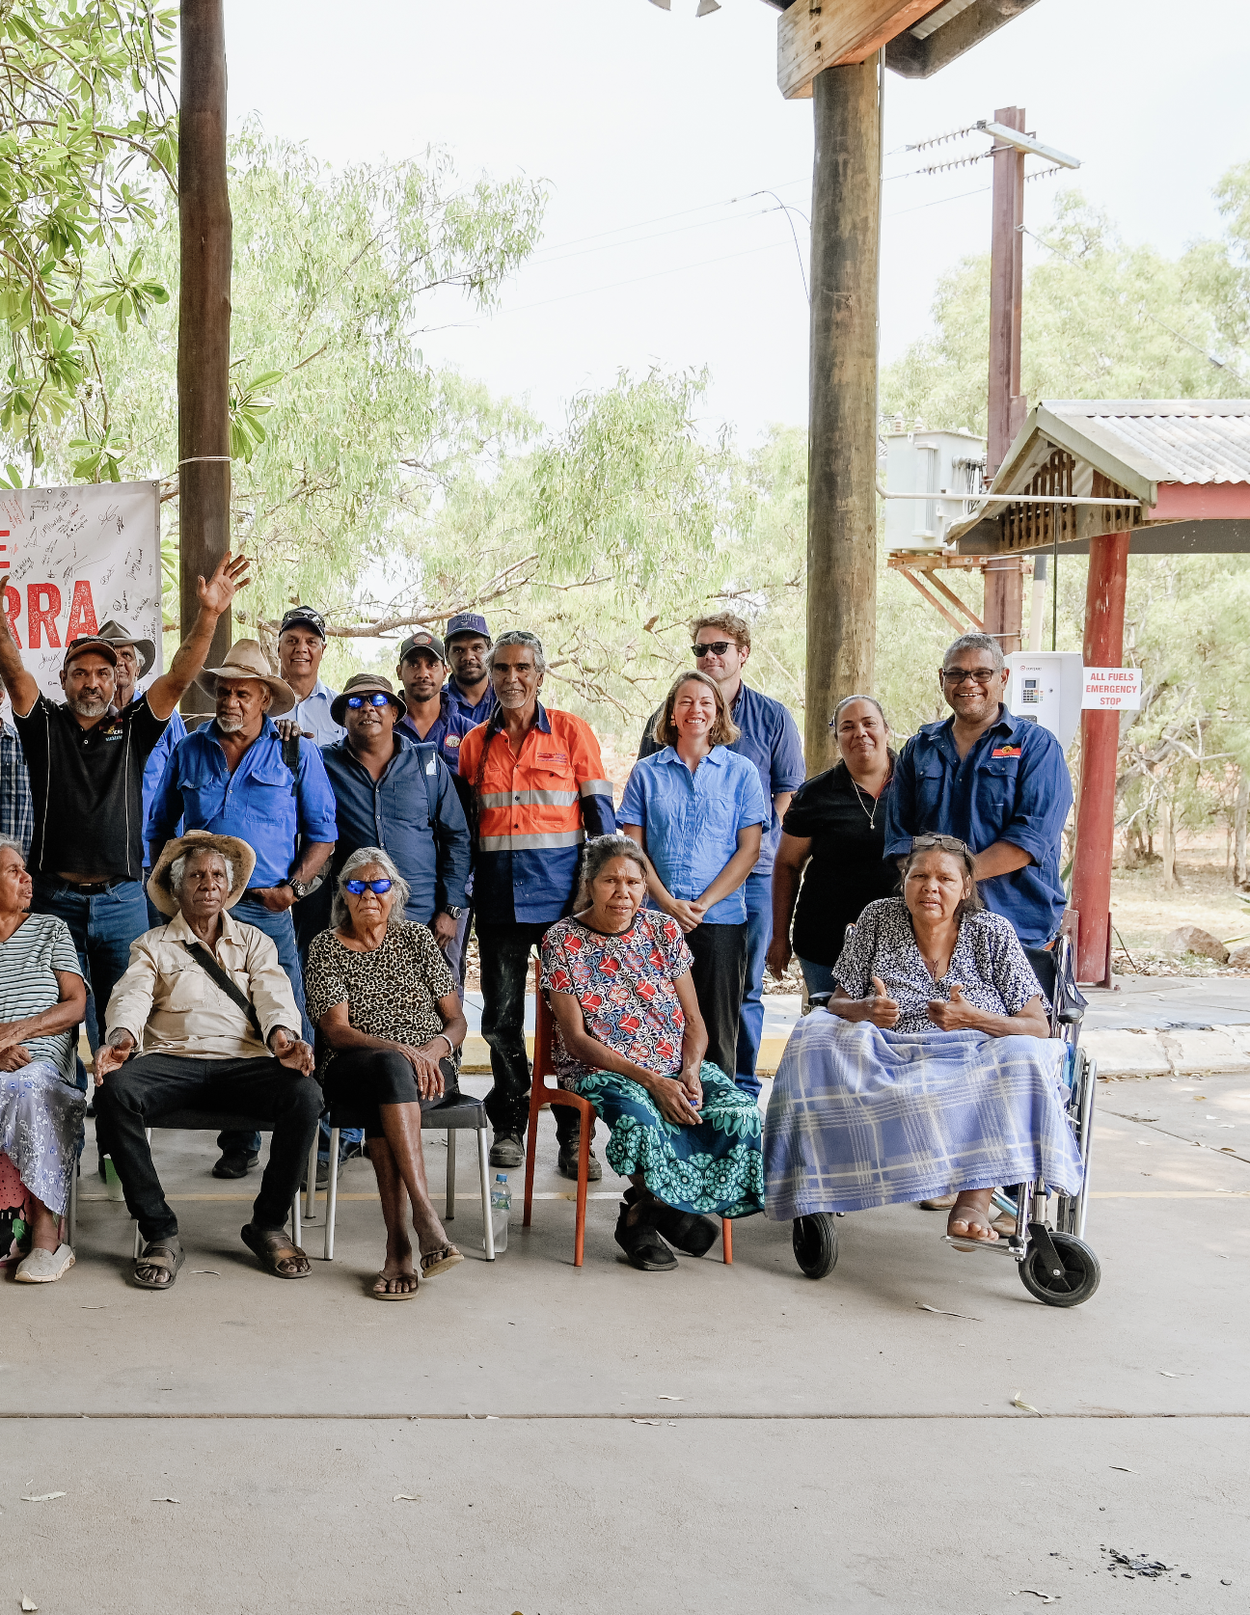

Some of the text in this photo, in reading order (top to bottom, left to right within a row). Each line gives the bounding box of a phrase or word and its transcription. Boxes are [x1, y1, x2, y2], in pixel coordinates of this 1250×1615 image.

[1090, 672, 1134, 681] ALL FUELS
[1086, 684, 1137, 694] EMERGENCY
[1100, 697, 1122, 706] STOP
